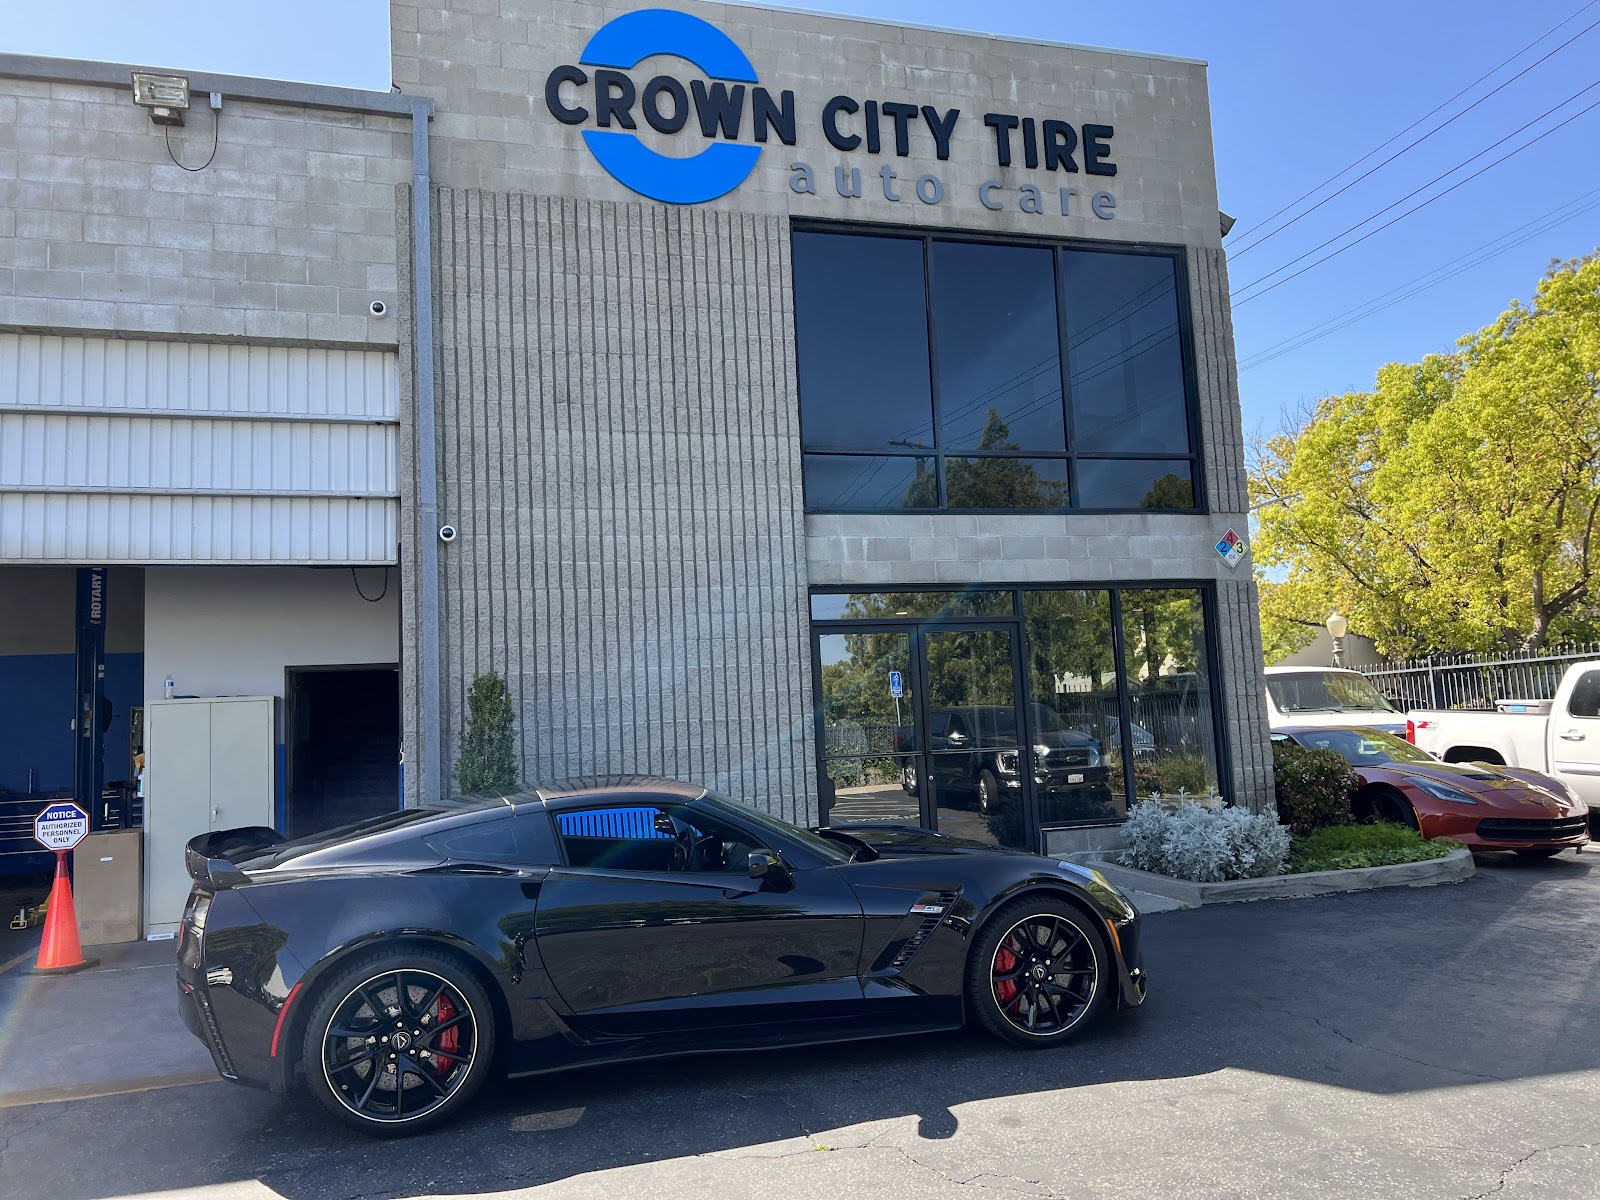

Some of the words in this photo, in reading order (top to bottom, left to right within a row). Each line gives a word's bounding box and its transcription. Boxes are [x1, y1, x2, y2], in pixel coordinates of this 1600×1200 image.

[545, 65, 797, 146] CROWN
[822, 95, 960, 160] CITY
[985, 111, 1118, 176] TIRE
[788, 161, 944, 204] auto
[979, 178, 1118, 220] care
[1227, 532, 1234, 544] 4
[1220, 541, 1227, 552] 2
[1236, 542, 1243, 553] 3
[90, 573, 102, 619] ROTARY
[46, 810, 77, 820] NOTICE
[41, 822, 82, 830] AUTHORIZED
[42, 829, 81, 837] PERSONNEL
